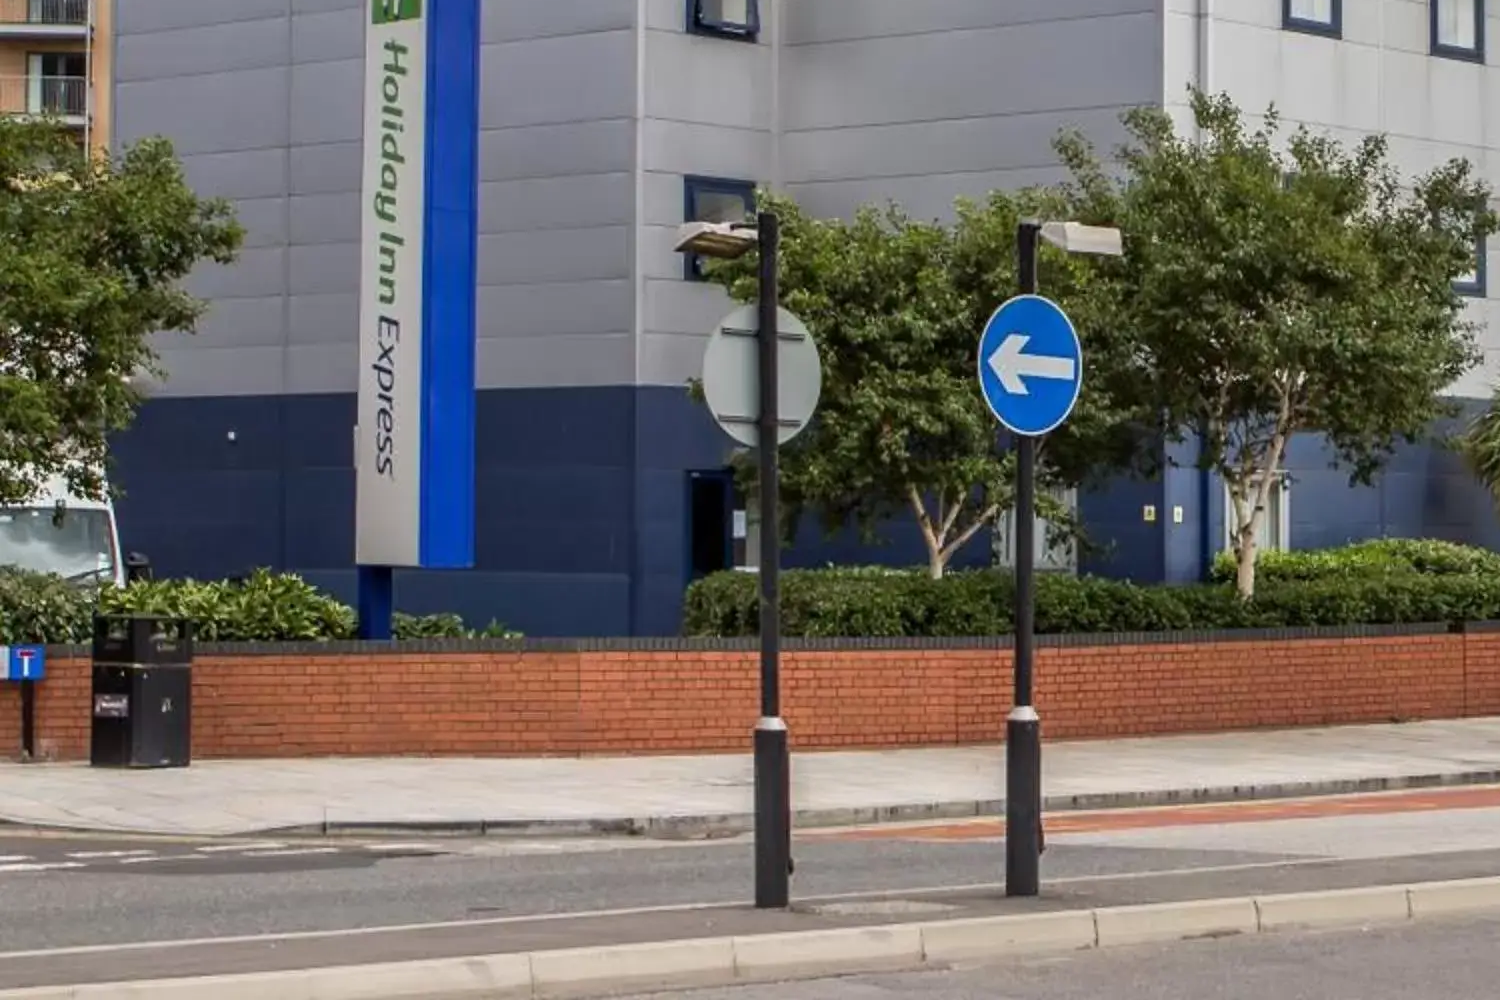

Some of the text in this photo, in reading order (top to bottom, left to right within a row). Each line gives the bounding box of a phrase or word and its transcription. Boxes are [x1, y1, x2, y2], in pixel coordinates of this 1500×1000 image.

[372, 38, 409, 480] Holiday Inn Express
